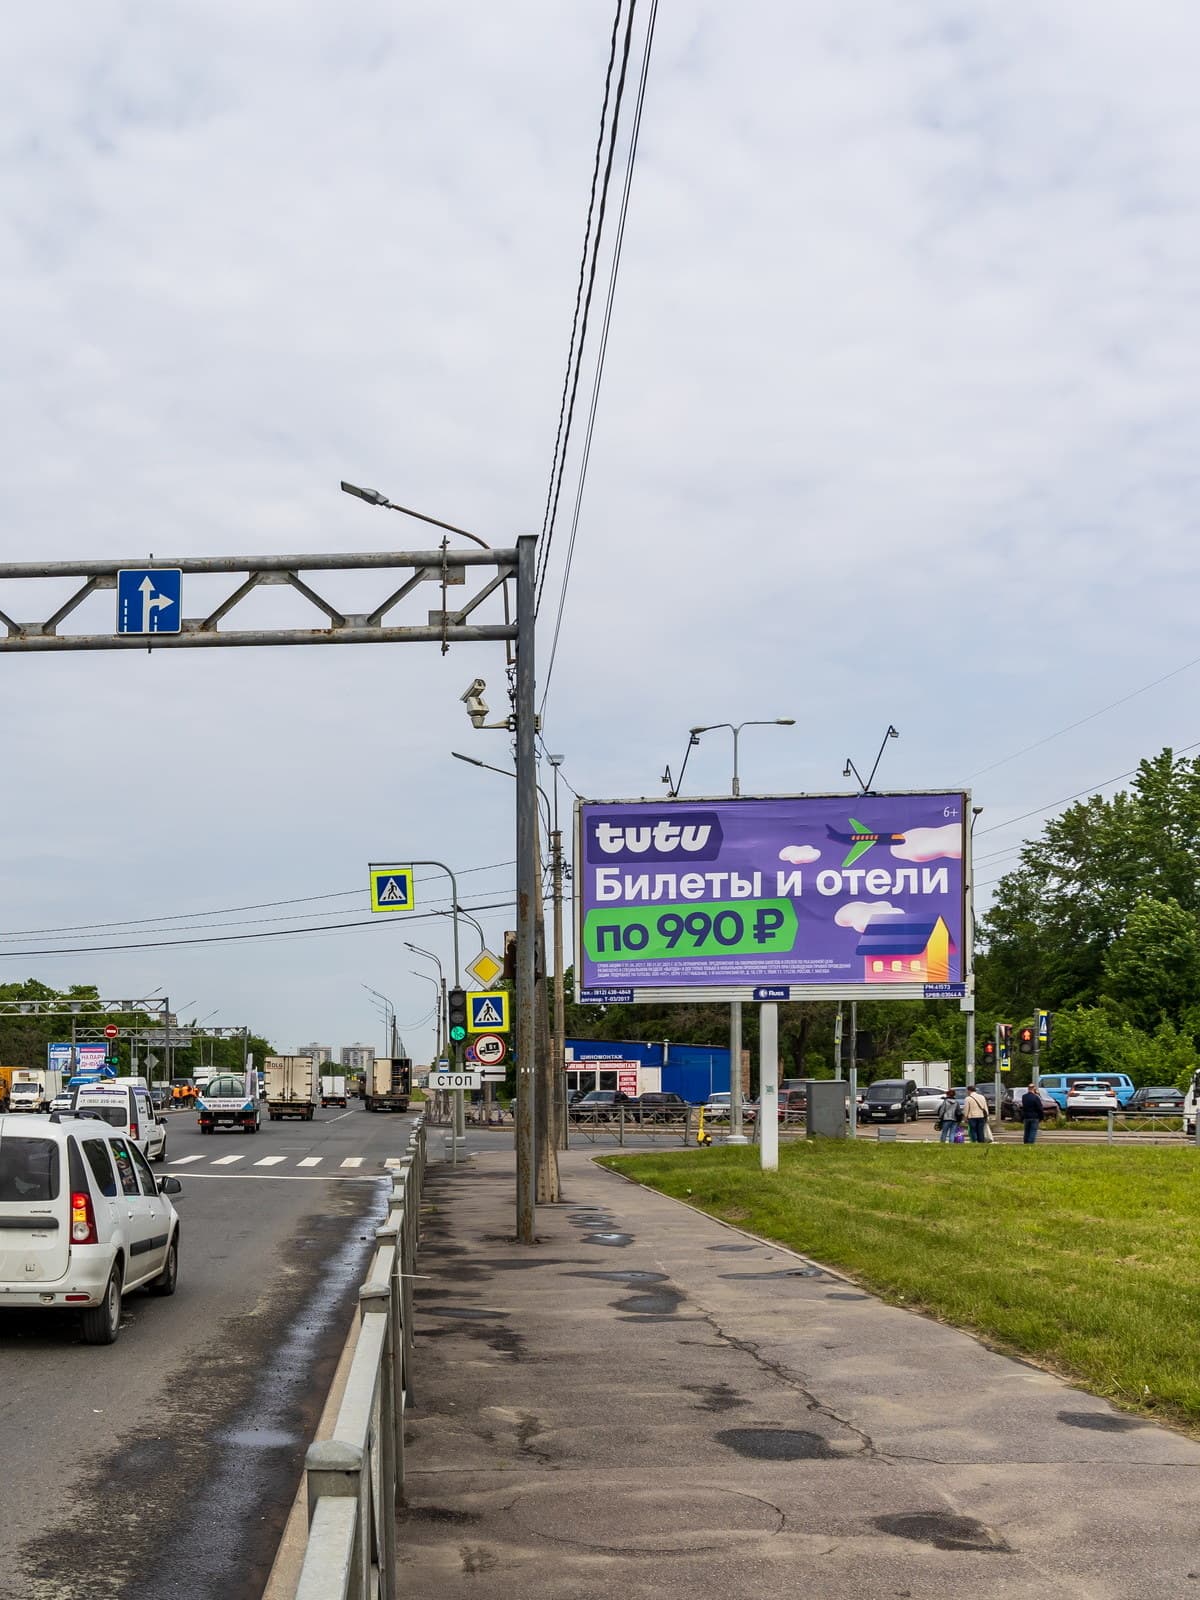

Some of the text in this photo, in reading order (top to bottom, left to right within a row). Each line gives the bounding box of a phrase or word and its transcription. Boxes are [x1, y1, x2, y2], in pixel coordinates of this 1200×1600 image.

[943, 806, 960, 818] 6+
[595, 821, 712, 854] tutu
[595, 867, 949, 901] Билеты и отели
[596, 908, 785, 952] по 990 ₽
[437, 1075, 472, 1086] СТОП
